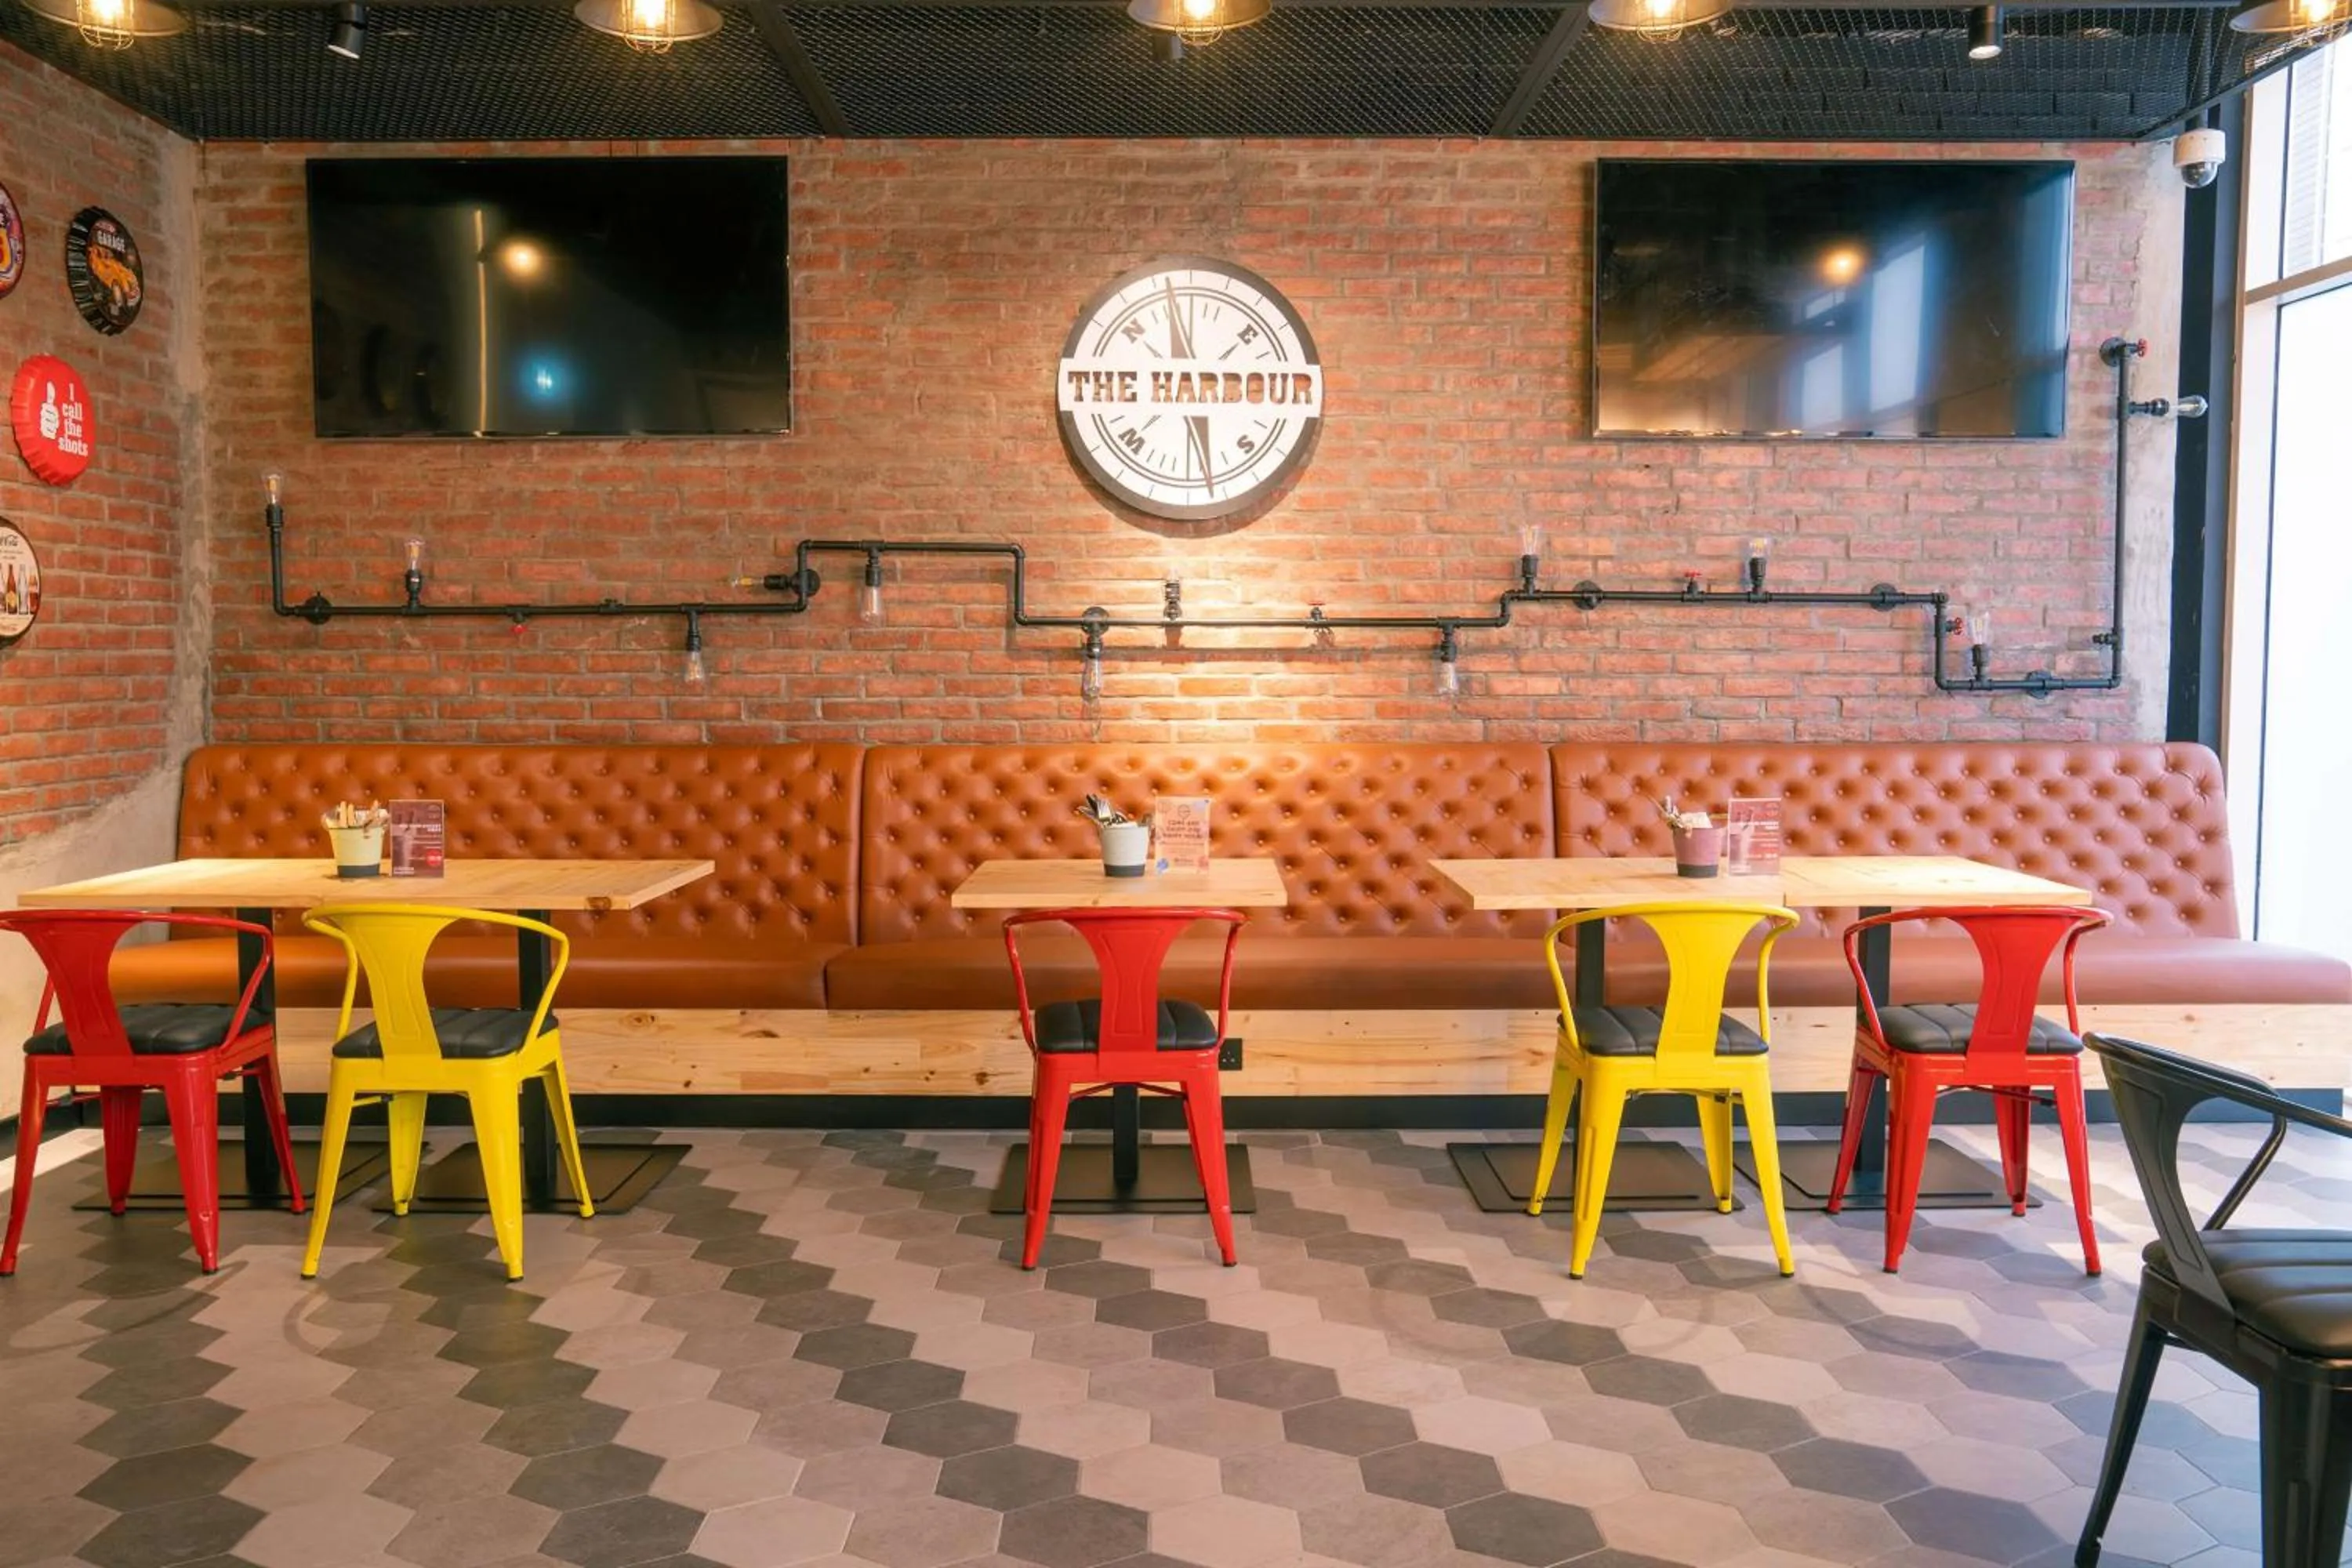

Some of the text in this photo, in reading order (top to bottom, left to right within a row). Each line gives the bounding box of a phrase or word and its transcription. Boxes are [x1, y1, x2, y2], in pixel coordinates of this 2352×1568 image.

[1121, 318, 1146, 343] N
[1237, 324, 1259, 345] E
[68, 383, 74, 401] I
[1068, 371, 1313, 405] THE HARBOUR
[62, 401, 82, 422] call
[64, 418, 82, 438] the
[58, 435, 89, 457] shots
[1236, 434, 1256, 455] S
